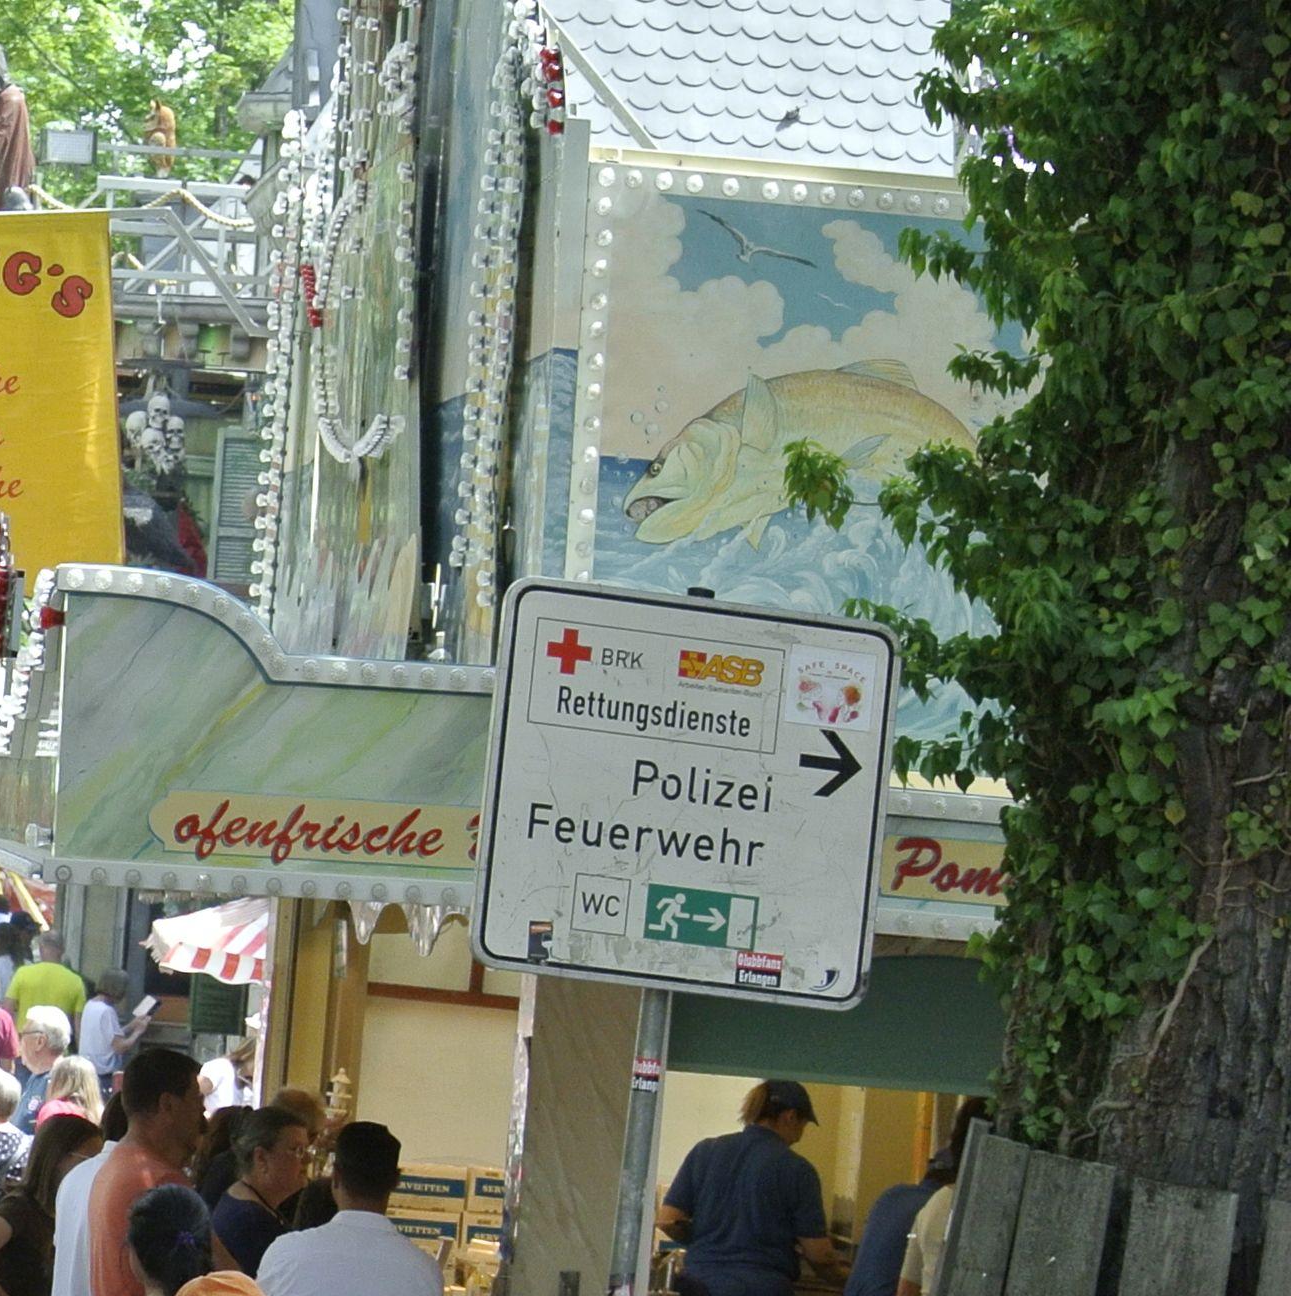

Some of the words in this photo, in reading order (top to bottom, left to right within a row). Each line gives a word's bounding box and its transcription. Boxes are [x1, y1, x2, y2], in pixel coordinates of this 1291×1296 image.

[602, 648, 644, 669] BRK
[698, 654, 765, 687] ASB
[557, 686, 751, 737] Rettungsdienste
[632, 760, 774, 813] Polizei
[174, 800, 445, 865] ofenfrische
[527, 803, 765, 867] Feuerwehr
[582, 892, 620, 917] WC
[738, 969, 778, 987] Erlangen
[395, 1223, 442, 1236] VIETTEN
